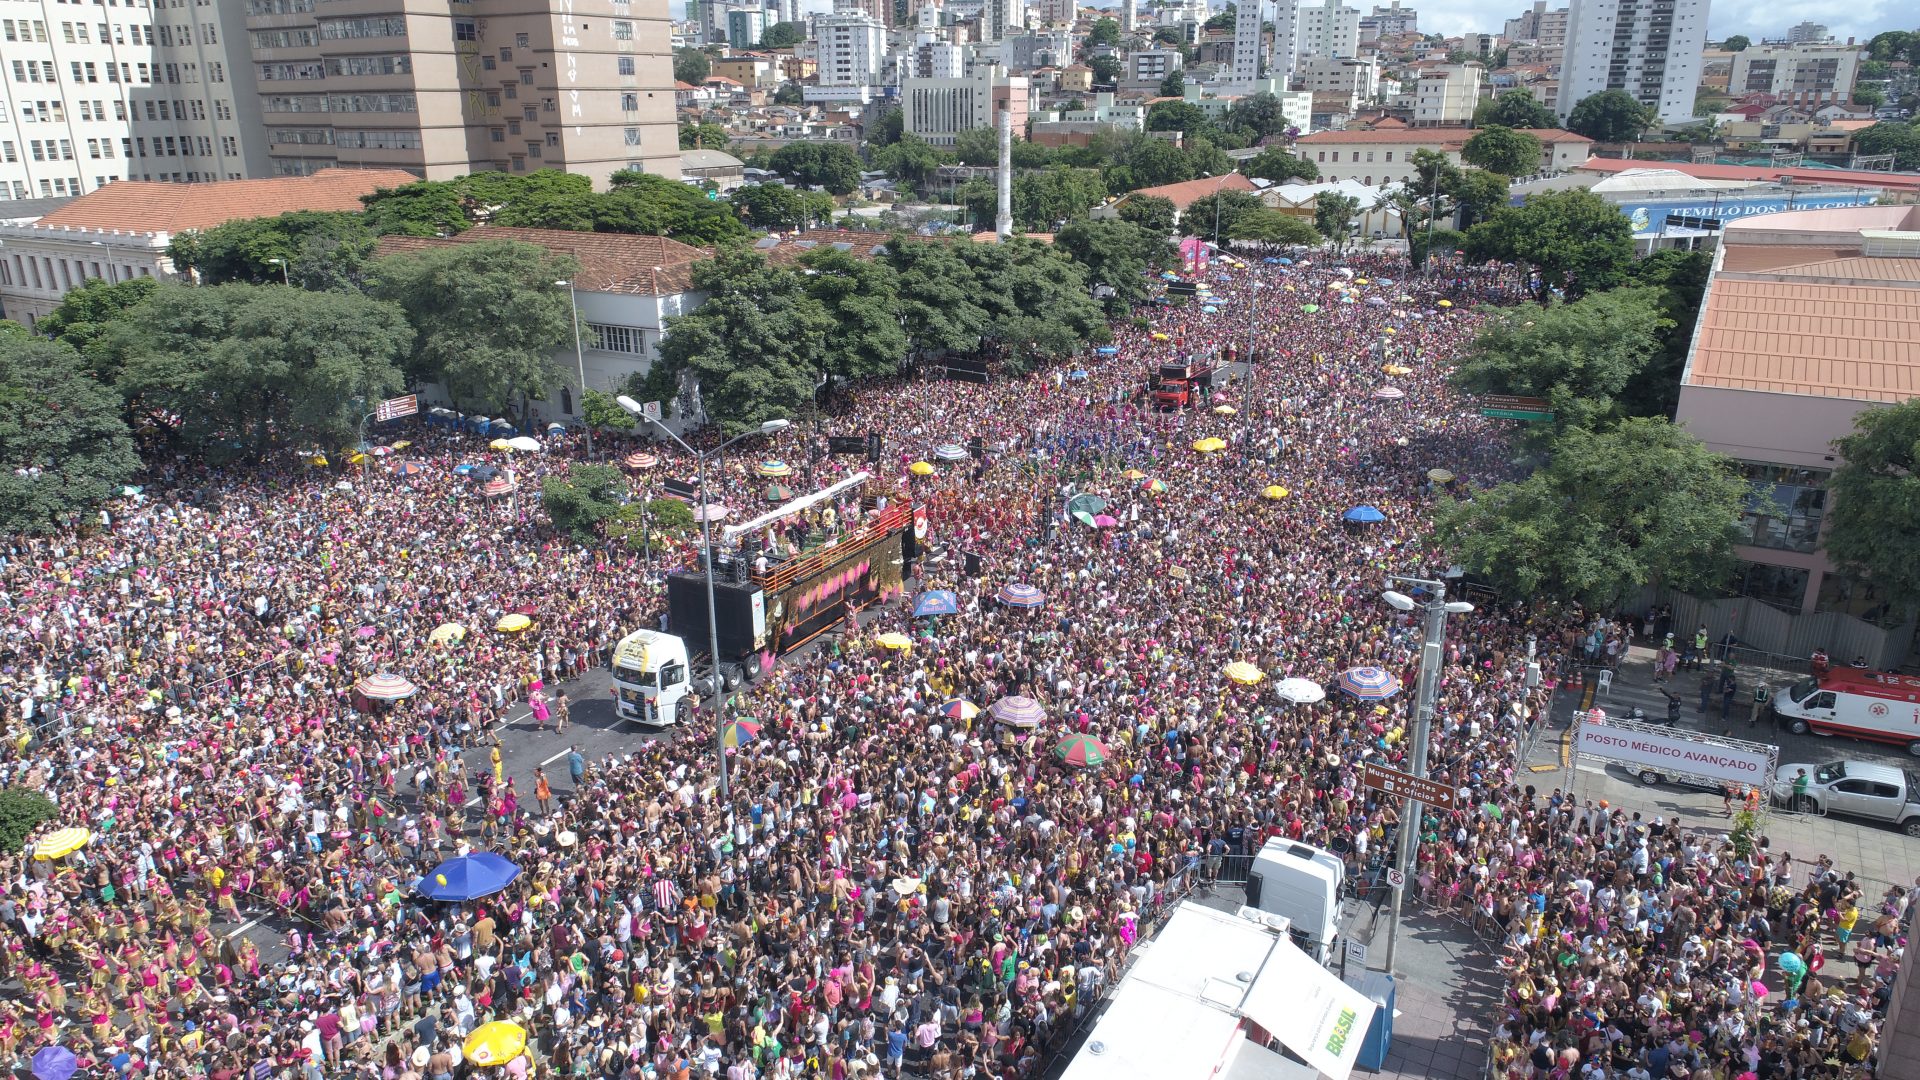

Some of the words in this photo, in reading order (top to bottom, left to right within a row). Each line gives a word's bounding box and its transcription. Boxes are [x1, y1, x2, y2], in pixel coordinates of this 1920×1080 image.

[1743, 205, 1777, 215] DOS
[1585, 733, 1628, 748] POSTO
[1631, 740, 1681, 758] MÉDICO
[1684, 751, 1758, 773] AVANÇADO
[1368, 767, 1395, 780] Museu
[1397, 776, 1408, 784] de
[1410, 780, 1436, 793] Artes
[1325, 1007, 1357, 1057] BRASIL
